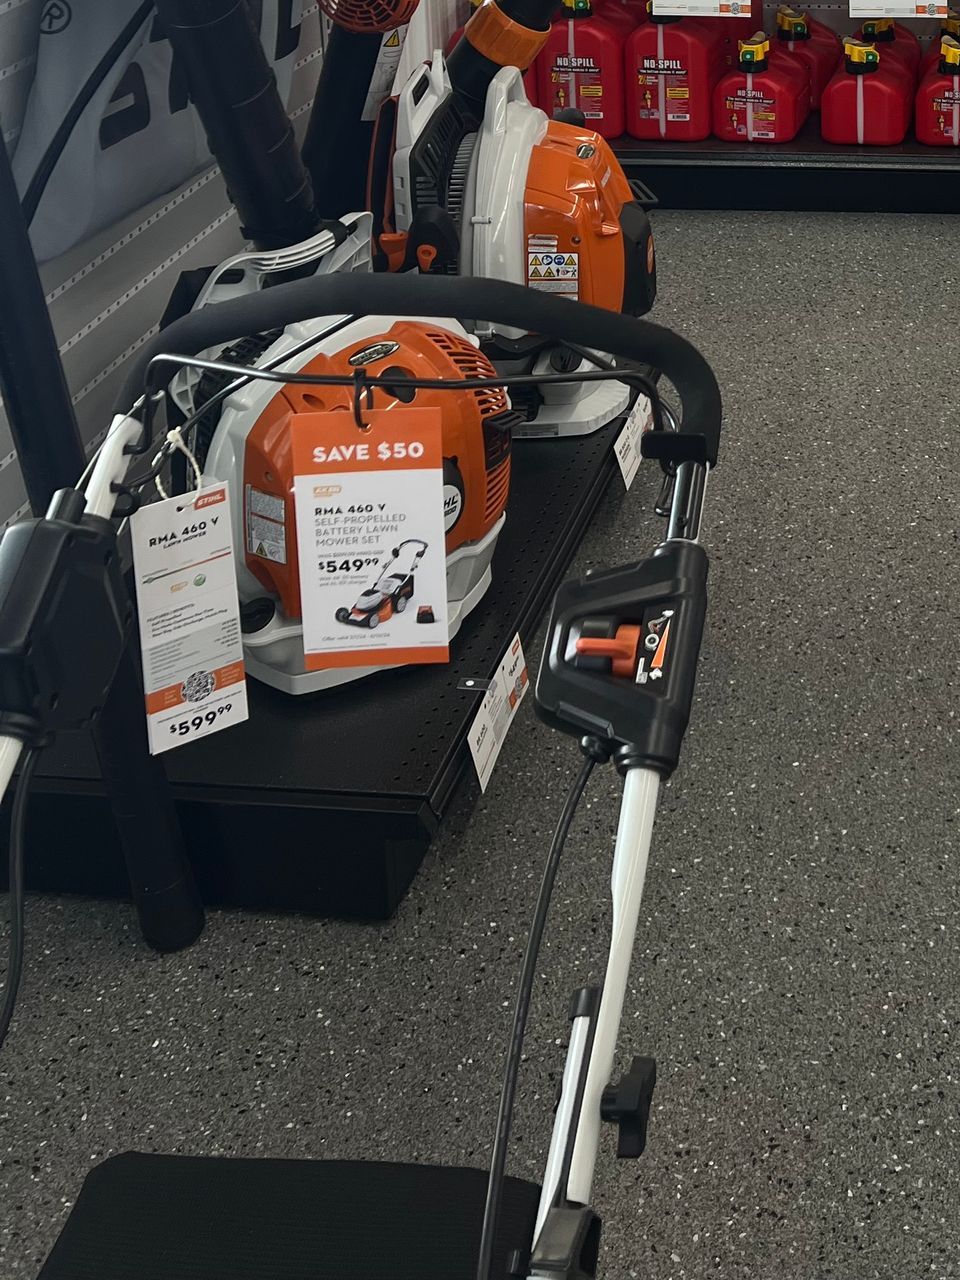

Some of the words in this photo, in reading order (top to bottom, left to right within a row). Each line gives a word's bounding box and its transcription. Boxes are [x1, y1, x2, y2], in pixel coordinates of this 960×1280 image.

[312, 443, 370, 463] SAVE
[377, 441, 425, 462] $50
[315, 506, 343, 516] RMA
[348, 504, 373, 514] 460
[378, 503, 386, 512] V
[315, 514, 406, 527] SELF-PROPELLED
[149, 532, 177, 548] RMA
[181, 521, 207, 535] 460
[211, 517, 219, 526] V
[315, 526, 362, 537] BATTERY
[366, 524, 399, 534] LAWN
[316, 536, 358, 547] MOWER
[362, 535, 381, 545] SET
